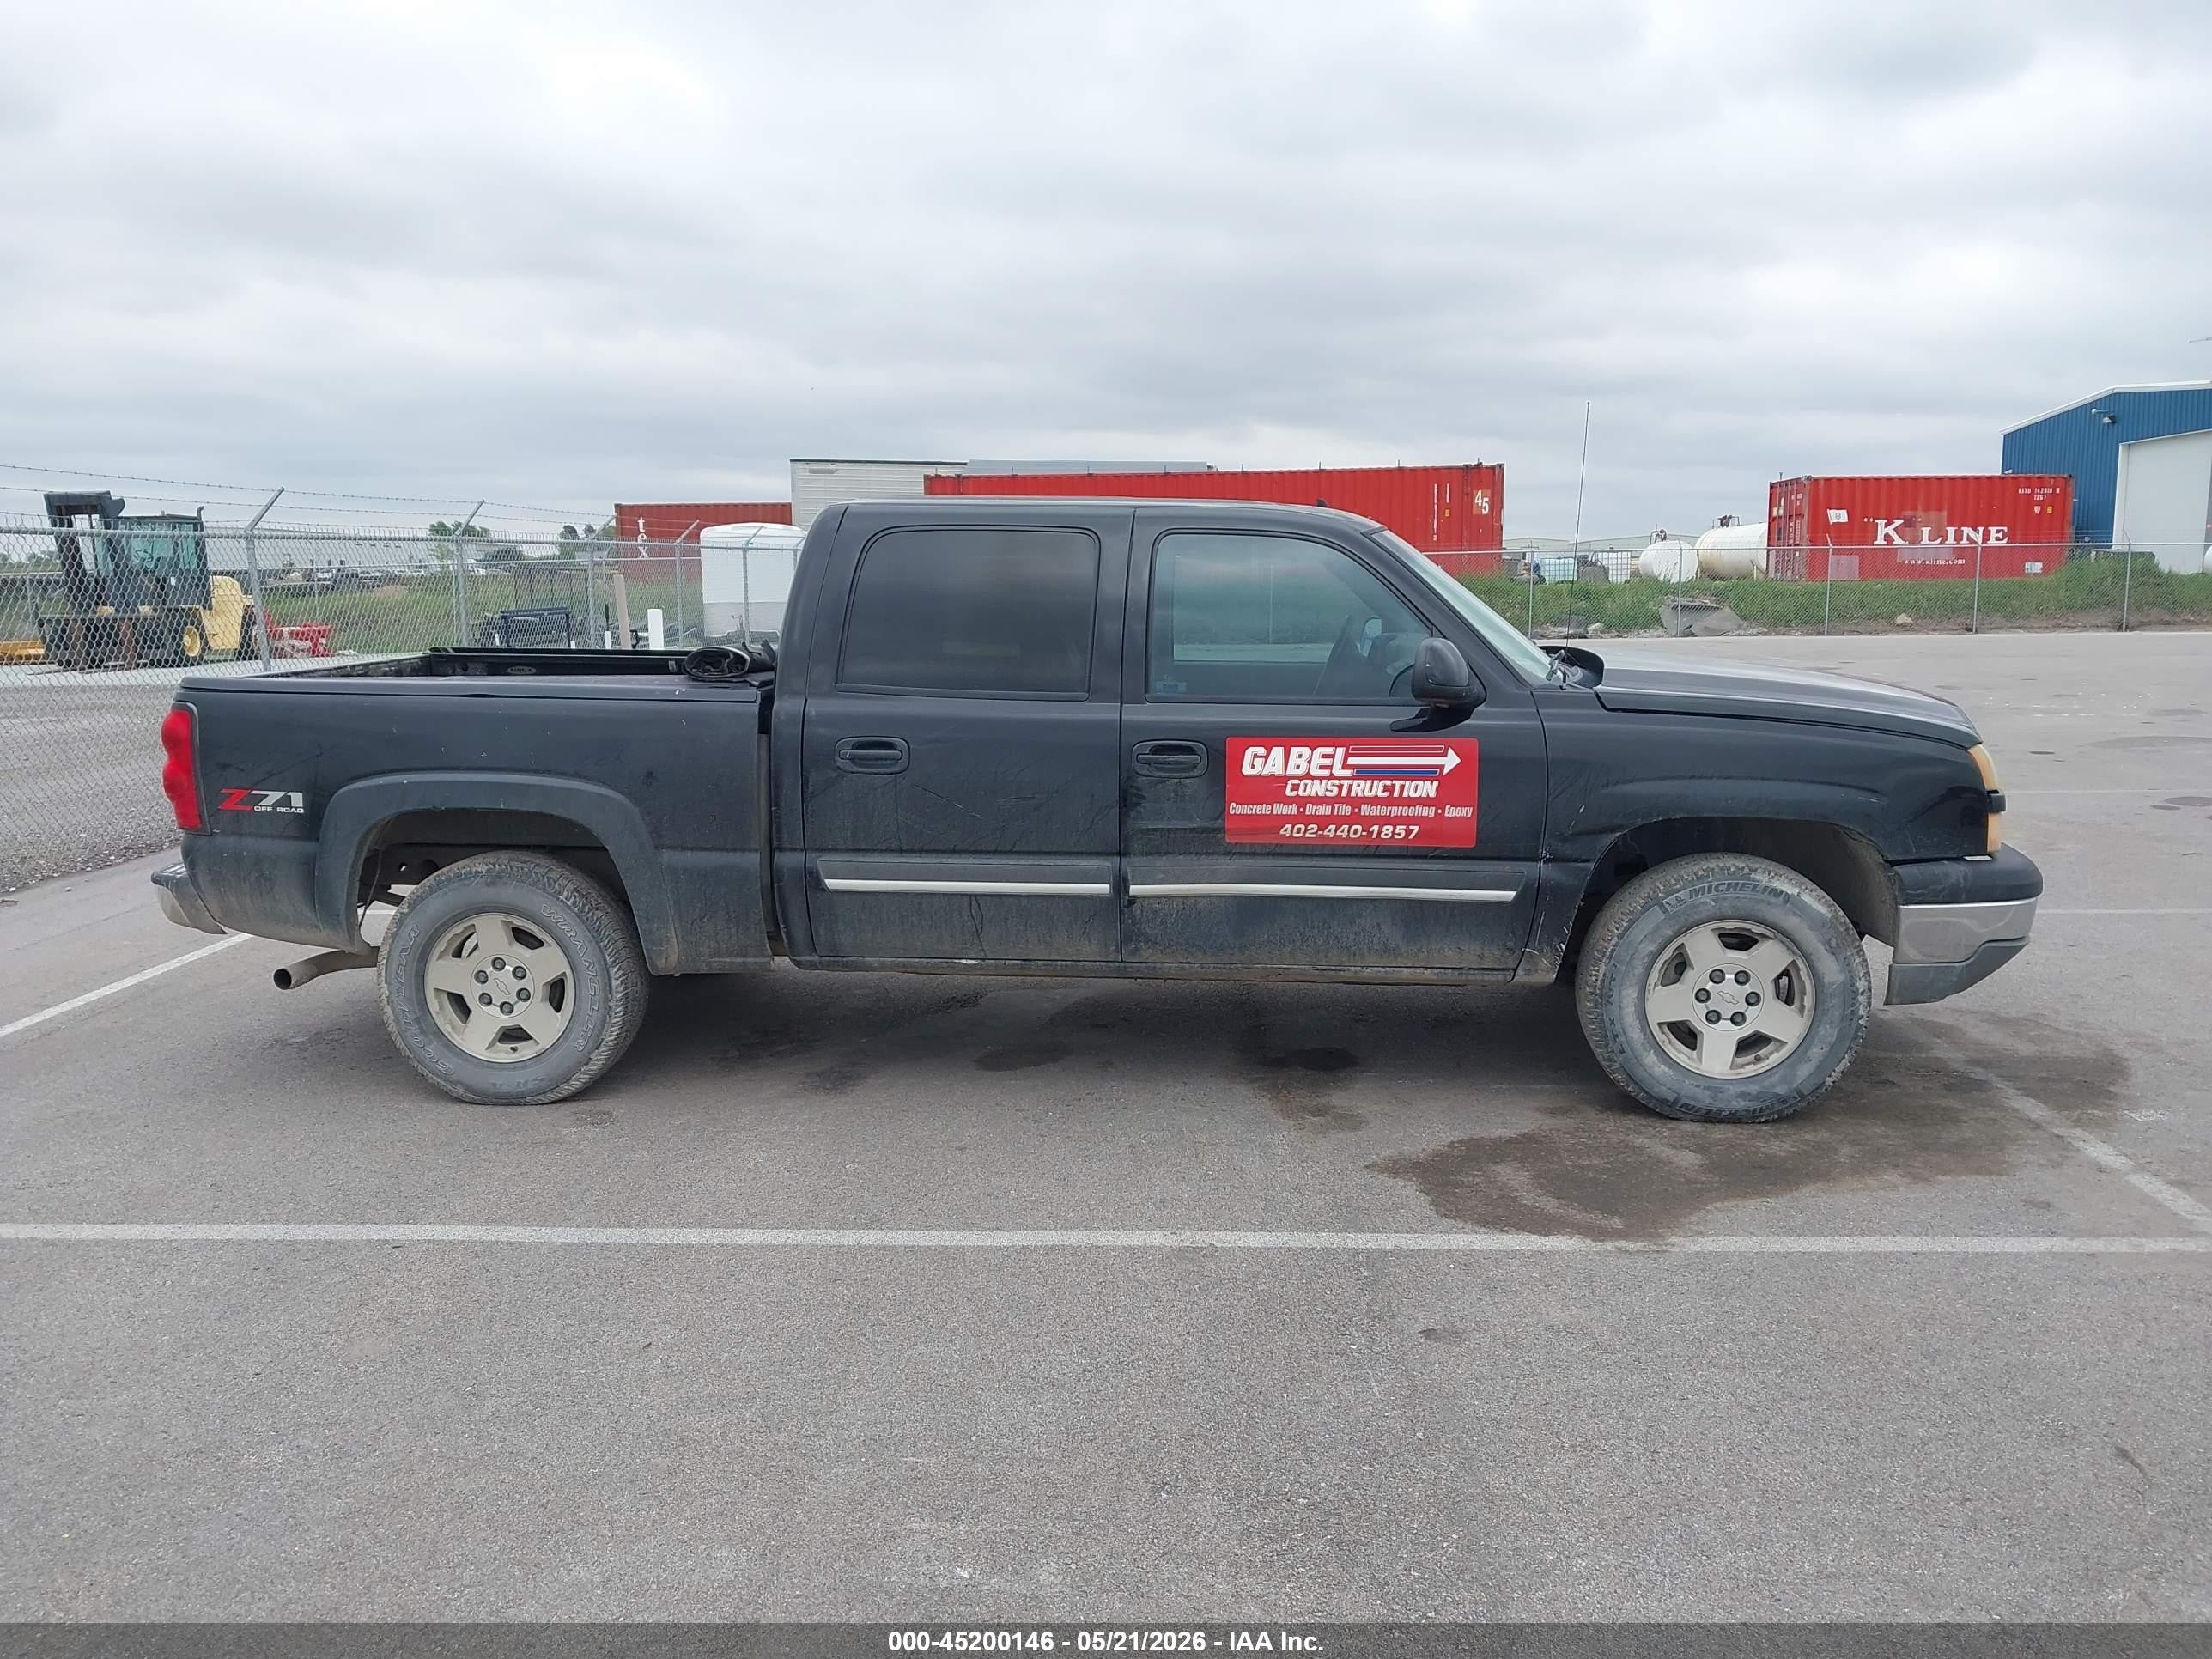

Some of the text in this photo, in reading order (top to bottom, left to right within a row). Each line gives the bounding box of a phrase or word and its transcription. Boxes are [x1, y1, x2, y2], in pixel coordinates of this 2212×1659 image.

[1474, 490, 1489, 514] 45
[1920, 527, 2008, 544] LINE
[1242, 746, 1355, 776] GABEL
[218, 788, 303, 811] Z71
[1285, 779, 1439, 798] CONSTRUCTION
[1230, 802, 1474, 817] Concrete Work Drain Tile Waterproofing Epoxy
[1279, 823, 1420, 839] 402-440-1857
[1689, 881, 1792, 903] MICHELIN
[541, 903, 599, 1053] WRANGLER
[392, 924, 454, 1075] GOODYEAR
